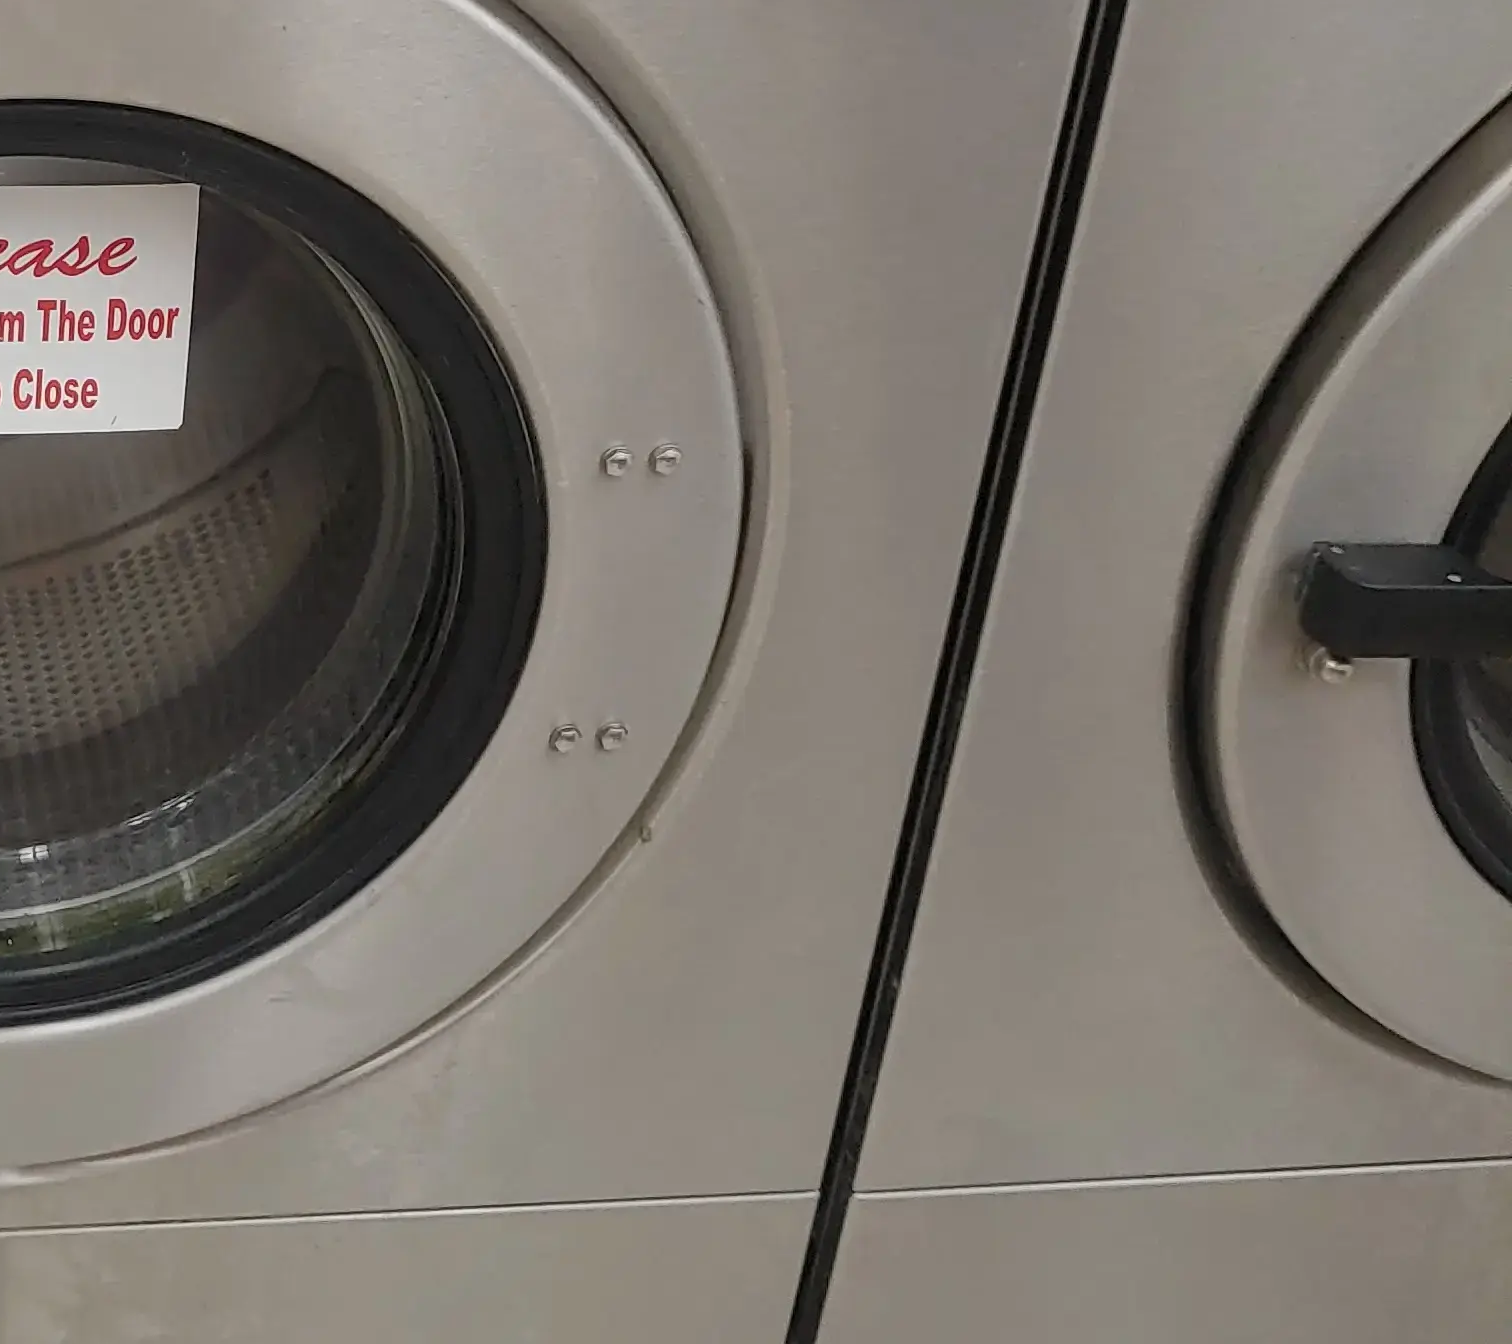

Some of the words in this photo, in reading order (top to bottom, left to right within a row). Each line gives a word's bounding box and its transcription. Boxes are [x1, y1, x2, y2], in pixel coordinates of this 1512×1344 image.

[37, 299, 95, 342] The
[107, 298, 180, 341] Door
[13, 368, 99, 410] Close
